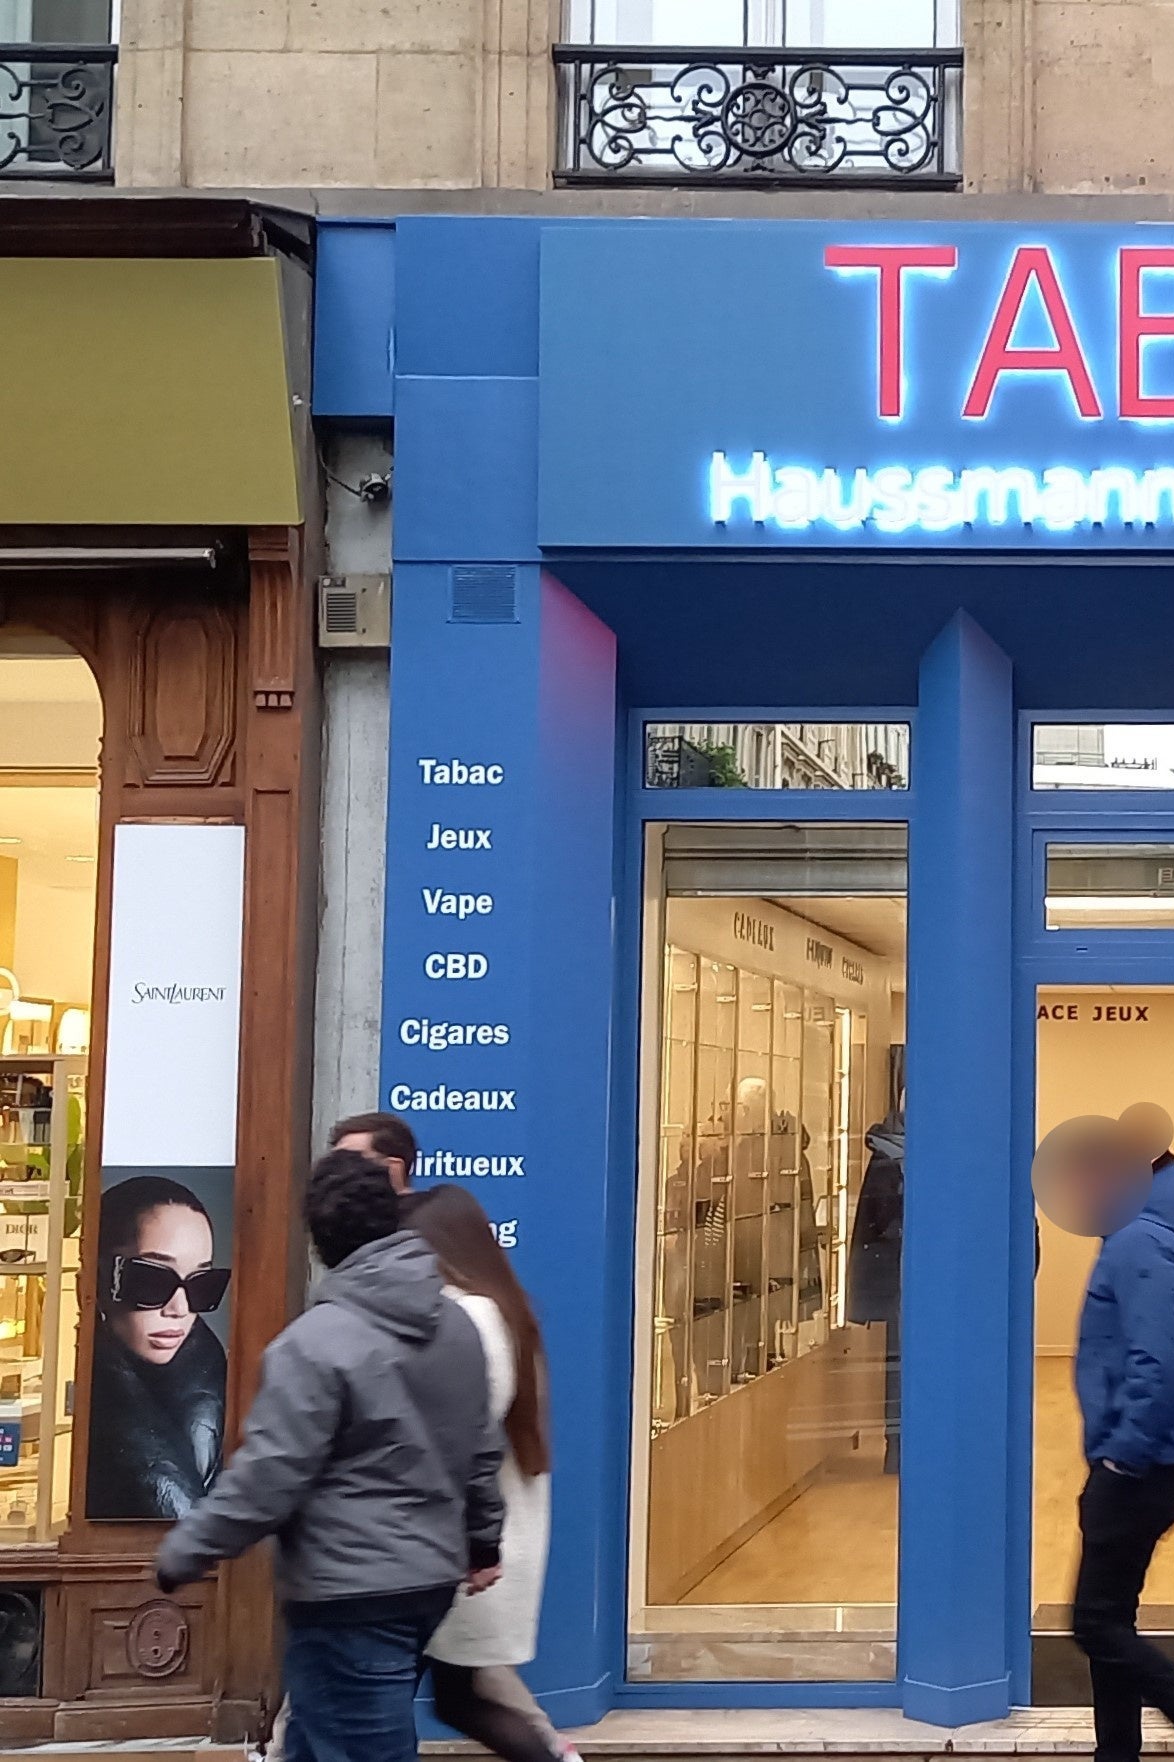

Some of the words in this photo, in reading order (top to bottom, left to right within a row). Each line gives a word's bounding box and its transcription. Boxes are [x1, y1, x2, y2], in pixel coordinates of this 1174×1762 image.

[418, 758, 505, 785] Tabac
[426, 823, 493, 850] Jeux
[422, 888, 494, 920] Vape
[424, 953, 489, 980] CBD
[1091, 1005, 1150, 1022] JEUX
[400, 1018, 511, 1051] Cigares
[389, 1084, 517, 1112] Cadeaux
[409, 1150, 526, 1177] iritueux
